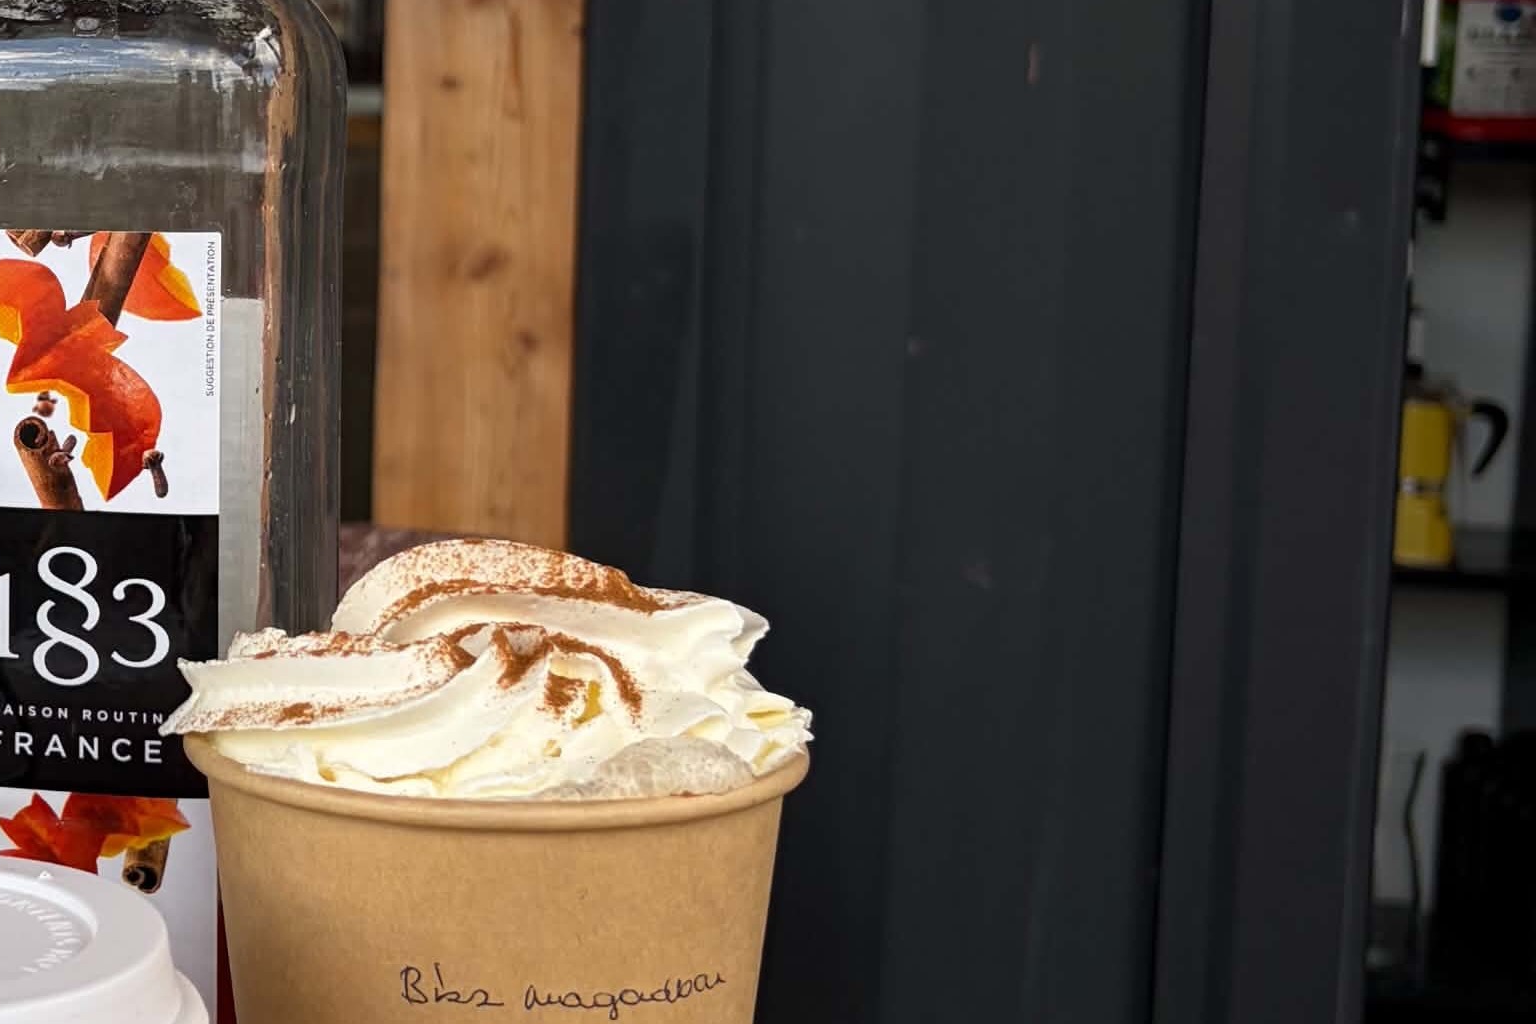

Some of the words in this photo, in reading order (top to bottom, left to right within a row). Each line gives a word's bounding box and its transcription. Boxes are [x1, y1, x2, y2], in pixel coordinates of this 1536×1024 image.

[206, 318, 216, 332] DE
[206, 334, 216, 396] SUGGESTION
[82, 708, 164, 725] ROUTIN
